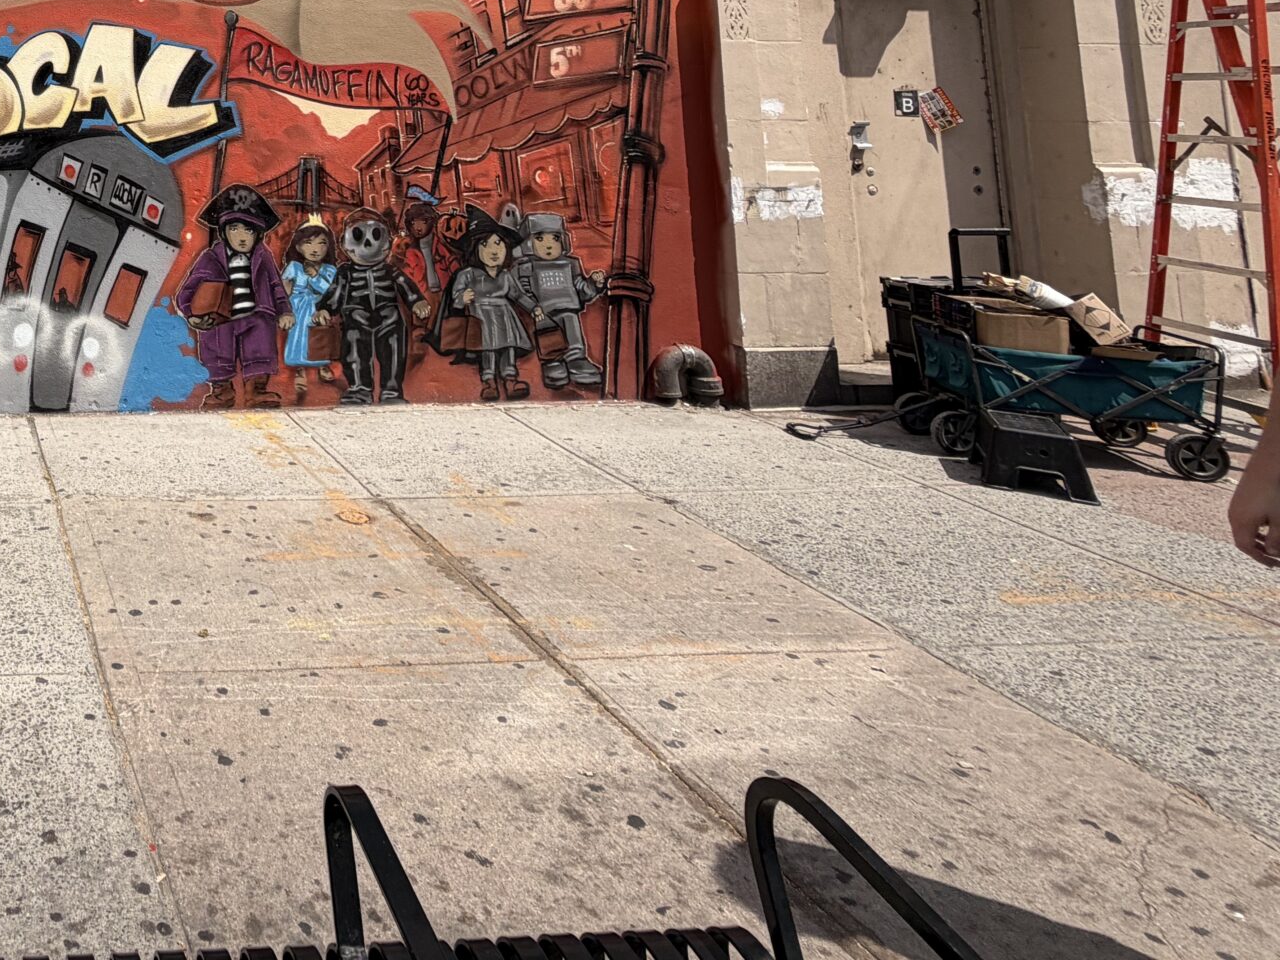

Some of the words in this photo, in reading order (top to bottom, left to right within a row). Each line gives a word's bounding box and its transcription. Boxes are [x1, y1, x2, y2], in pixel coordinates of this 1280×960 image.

[241, 40, 402, 108] RAGAMUFFIN
[404, 91, 441, 108] YEARS
[902, 97, 915, 113] B
[89, 172, 101, 193] R
